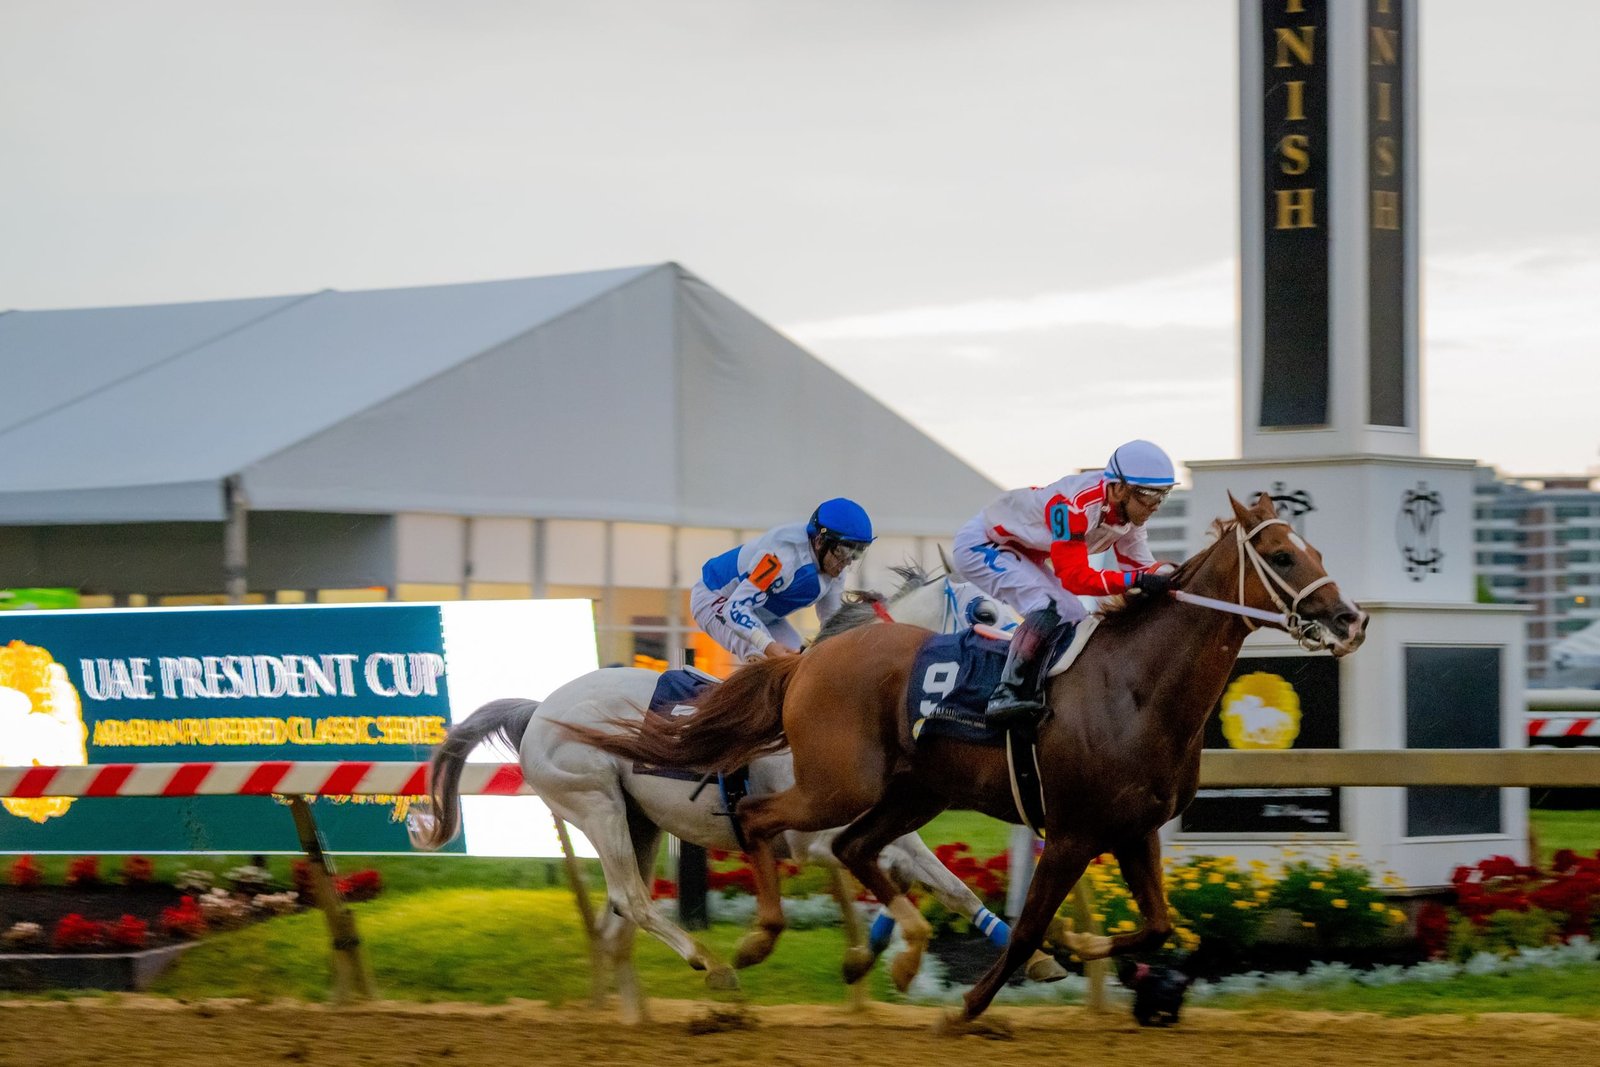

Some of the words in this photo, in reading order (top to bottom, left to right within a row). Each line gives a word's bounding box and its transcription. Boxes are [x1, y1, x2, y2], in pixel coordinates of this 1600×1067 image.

[1053, 506, 1065, 537] 9
[754, 558, 777, 582] 7
[80, 657, 156, 701] UAE
[158, 652, 359, 700] PRESIDENT
[364, 651, 446, 697] CUP
[920, 661, 960, 717] 9
